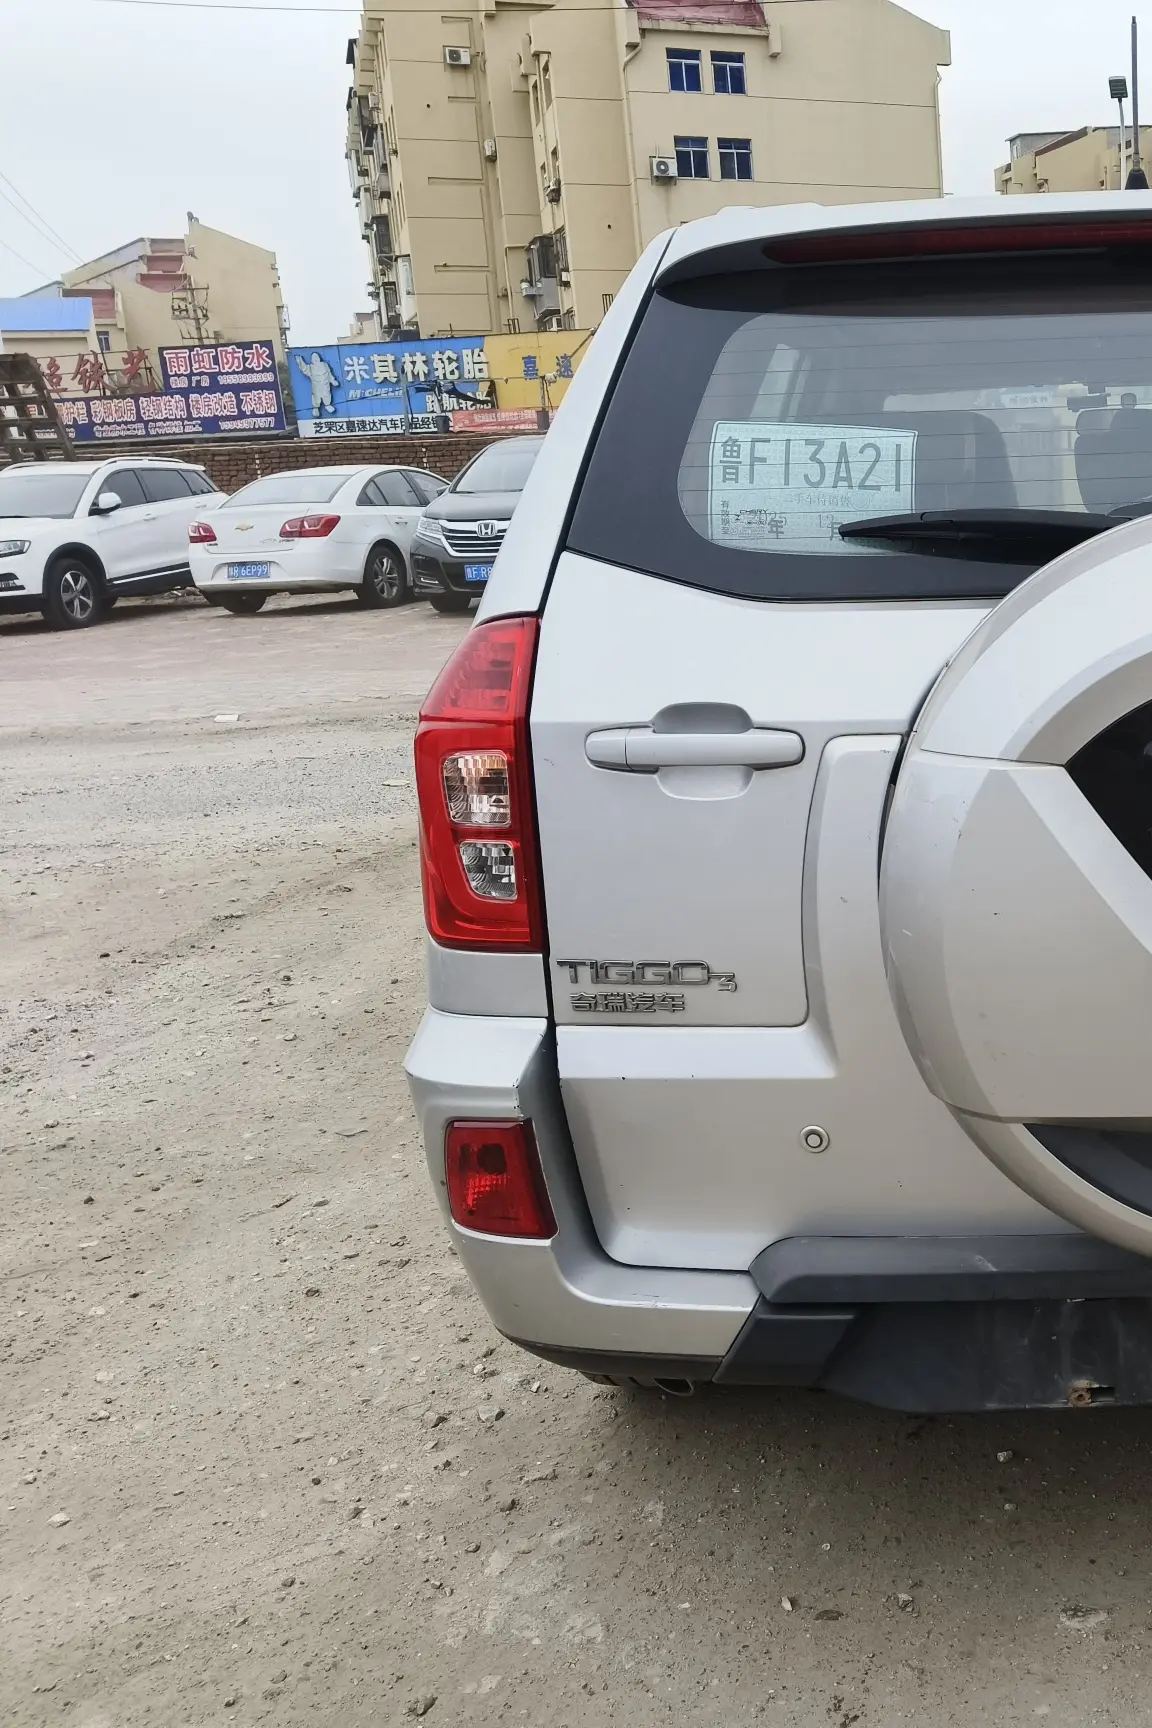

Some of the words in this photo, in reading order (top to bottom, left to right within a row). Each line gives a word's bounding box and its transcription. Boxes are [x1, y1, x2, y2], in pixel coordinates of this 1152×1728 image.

[163, 344, 272, 375] 雨虹防水
[344, 348, 489, 384] 米其林轮胎
[90, 398, 137, 423] 彩钢板房
[139, 394, 187, 420] 轻钢结构
[189, 392, 238, 418] 楼房改造
[240, 390, 277, 415] 不锈钢
[569, 992, 686, 1013] 奇瑞汽车
